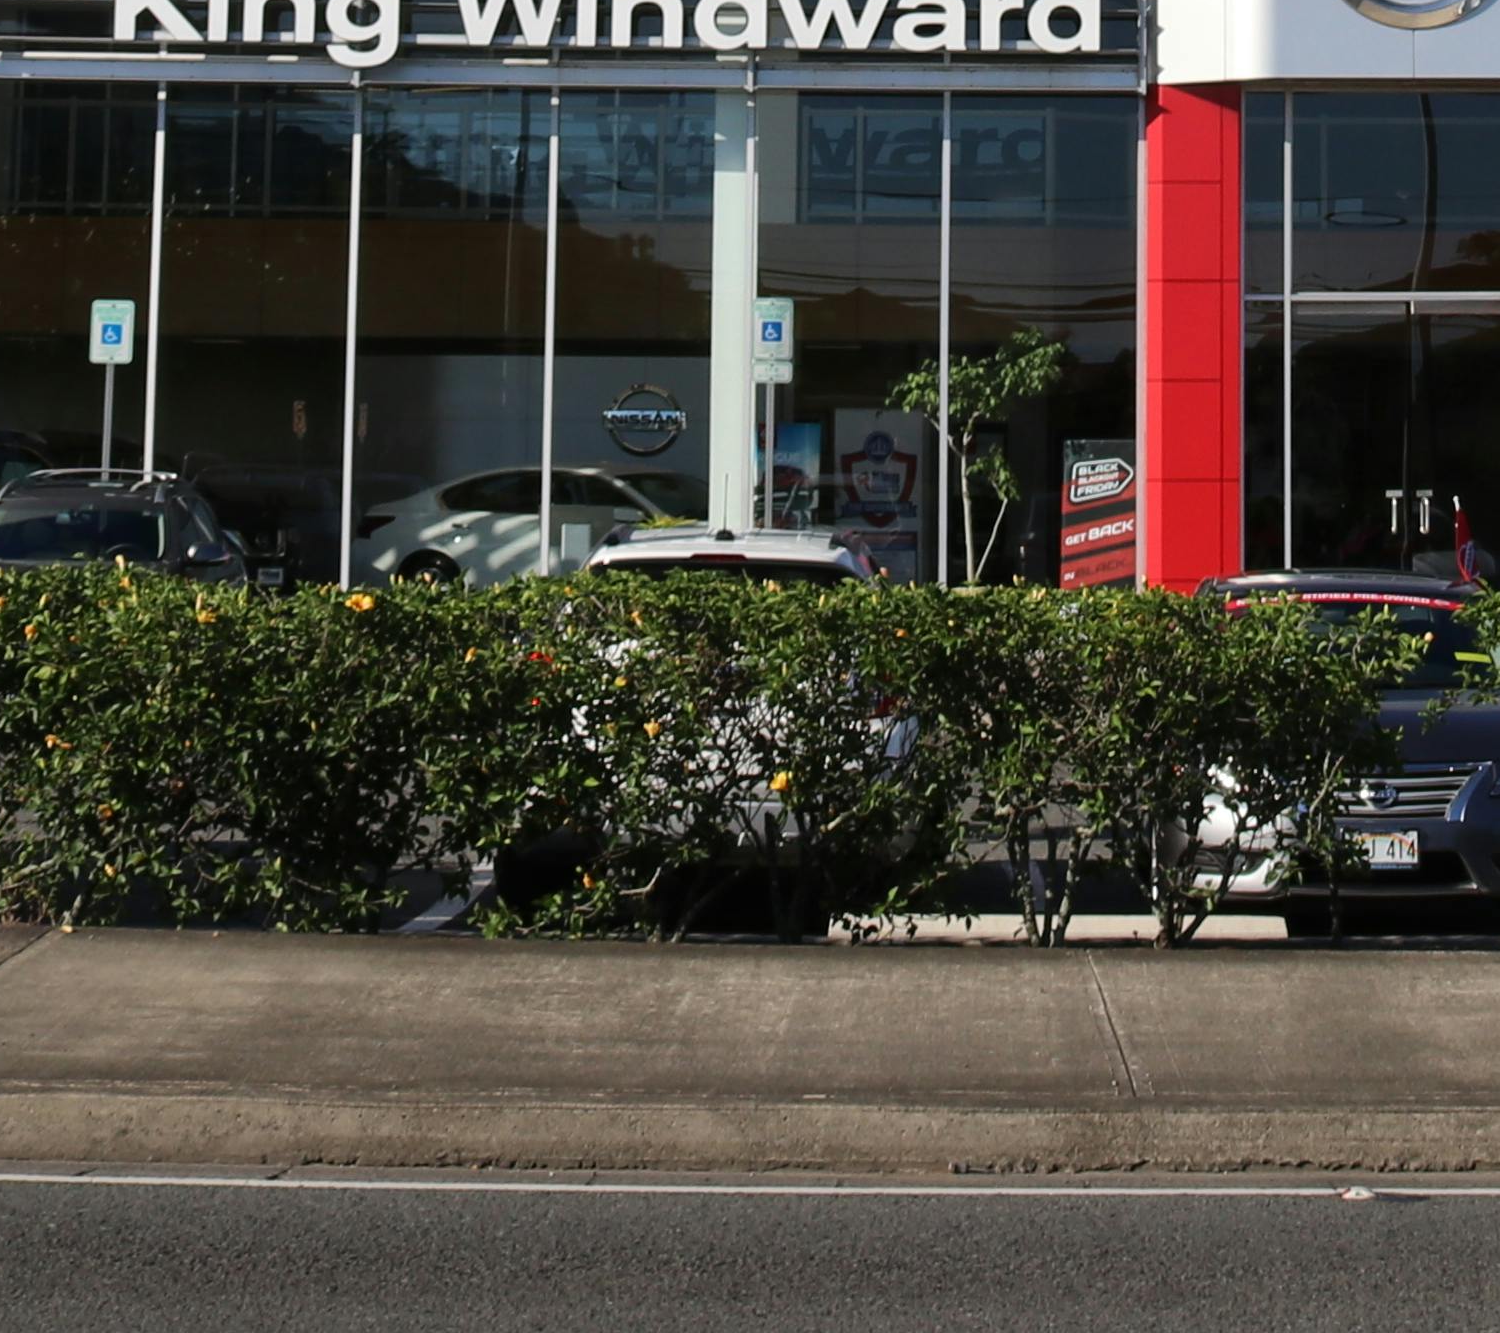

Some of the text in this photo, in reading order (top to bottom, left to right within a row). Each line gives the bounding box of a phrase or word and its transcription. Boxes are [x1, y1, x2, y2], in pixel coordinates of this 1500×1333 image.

[610, 412, 681, 428] NISSAN
[1078, 462, 1119, 476] BLACK
[1076, 480, 1120, 497] FRIDAY
[1065, 519, 1134, 546] GET BACK
